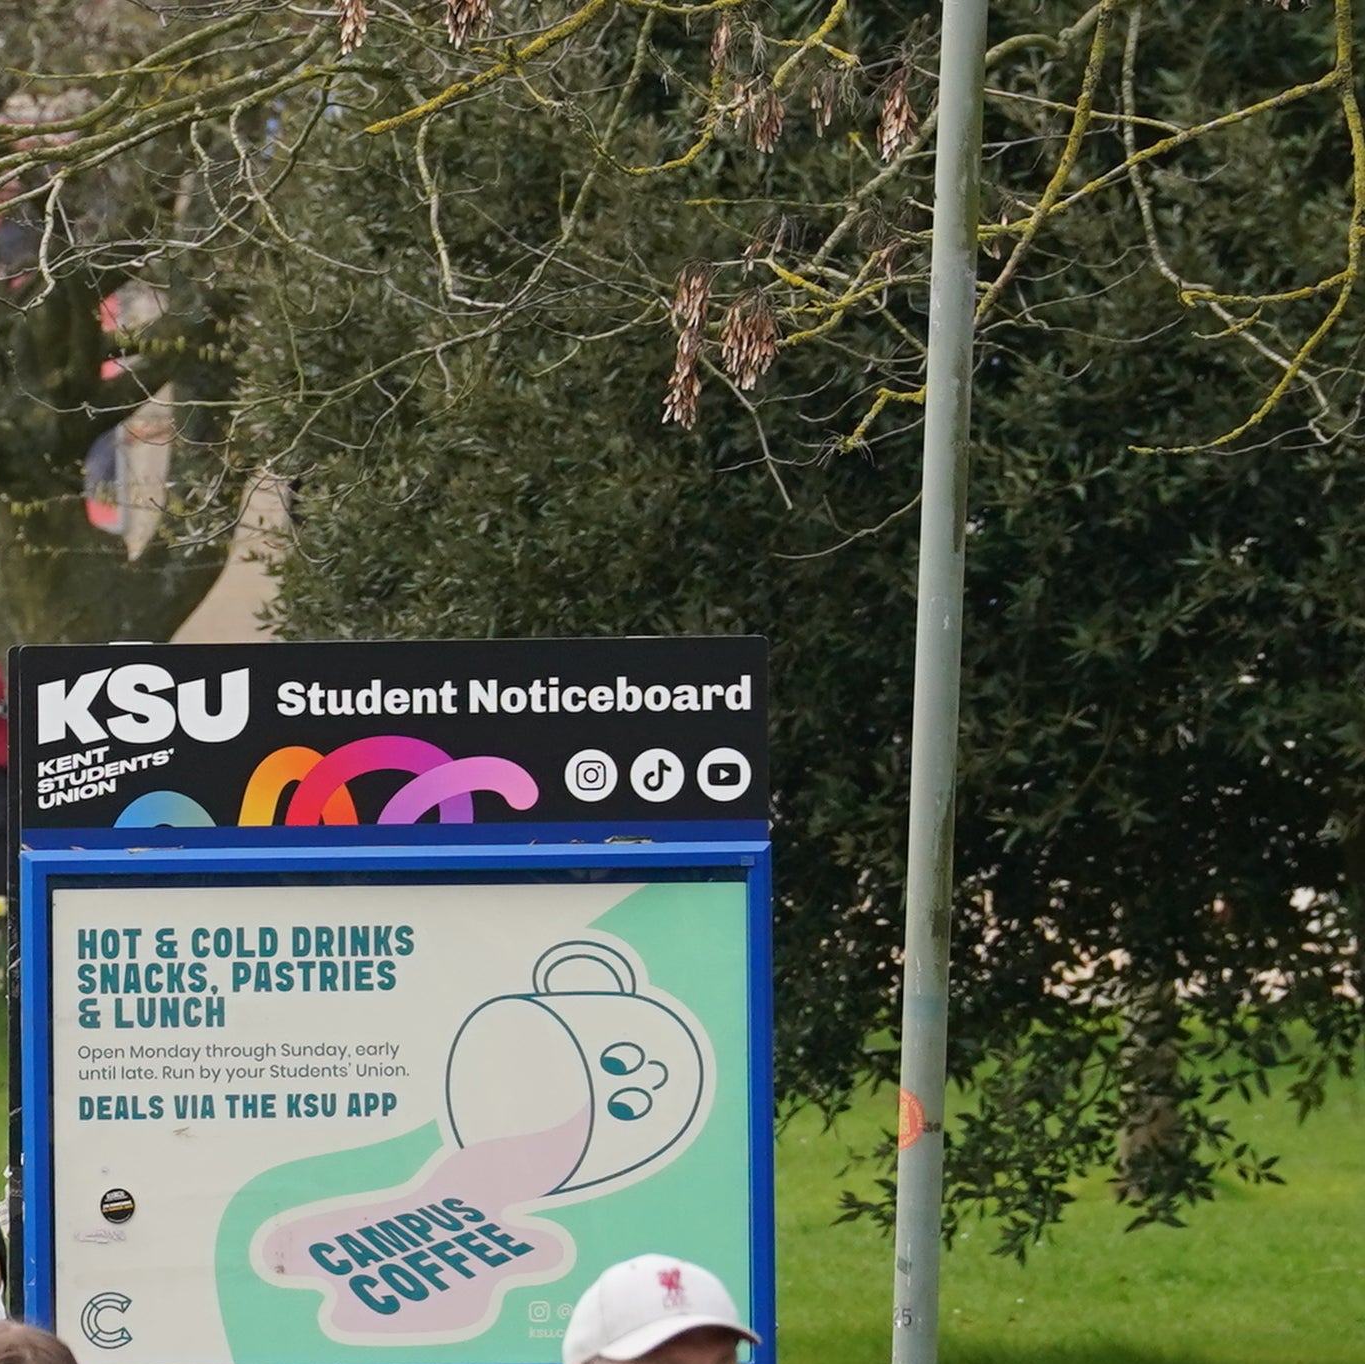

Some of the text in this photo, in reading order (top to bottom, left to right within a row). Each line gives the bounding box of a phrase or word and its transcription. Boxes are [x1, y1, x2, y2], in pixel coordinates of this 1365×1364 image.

[37, 664, 250, 745] KSU
[276, 674, 752, 716] Student Noticeboard
[37, 746, 110, 778] KENT
[37, 747, 175, 794] STUDENTS'
[37, 778, 117, 810] UNION
[77, 924, 415, 959] HOT & COLD DRINKS
[77, 959, 397, 996] SNACKS, PASTRIES
[78, 996, 225, 1029] & LUNCH
[77, 1042, 400, 1063] Open Monday through Sunday, early
[78, 1066, 117, 1081] until
[120, 1066, 158, 1081] late.
[162, 1066, 195, 1080] Run
[199, 1065, 221, 1083] by
[225, 1067, 267, 1083] your
[355, 1062, 410, 1078] Union.
[78, 1092, 398, 1121] DEALS VIA THE KSU APP
[308, 1198, 486, 1276] CAMPUS
[348, 1223, 536, 1316] COFFEE
